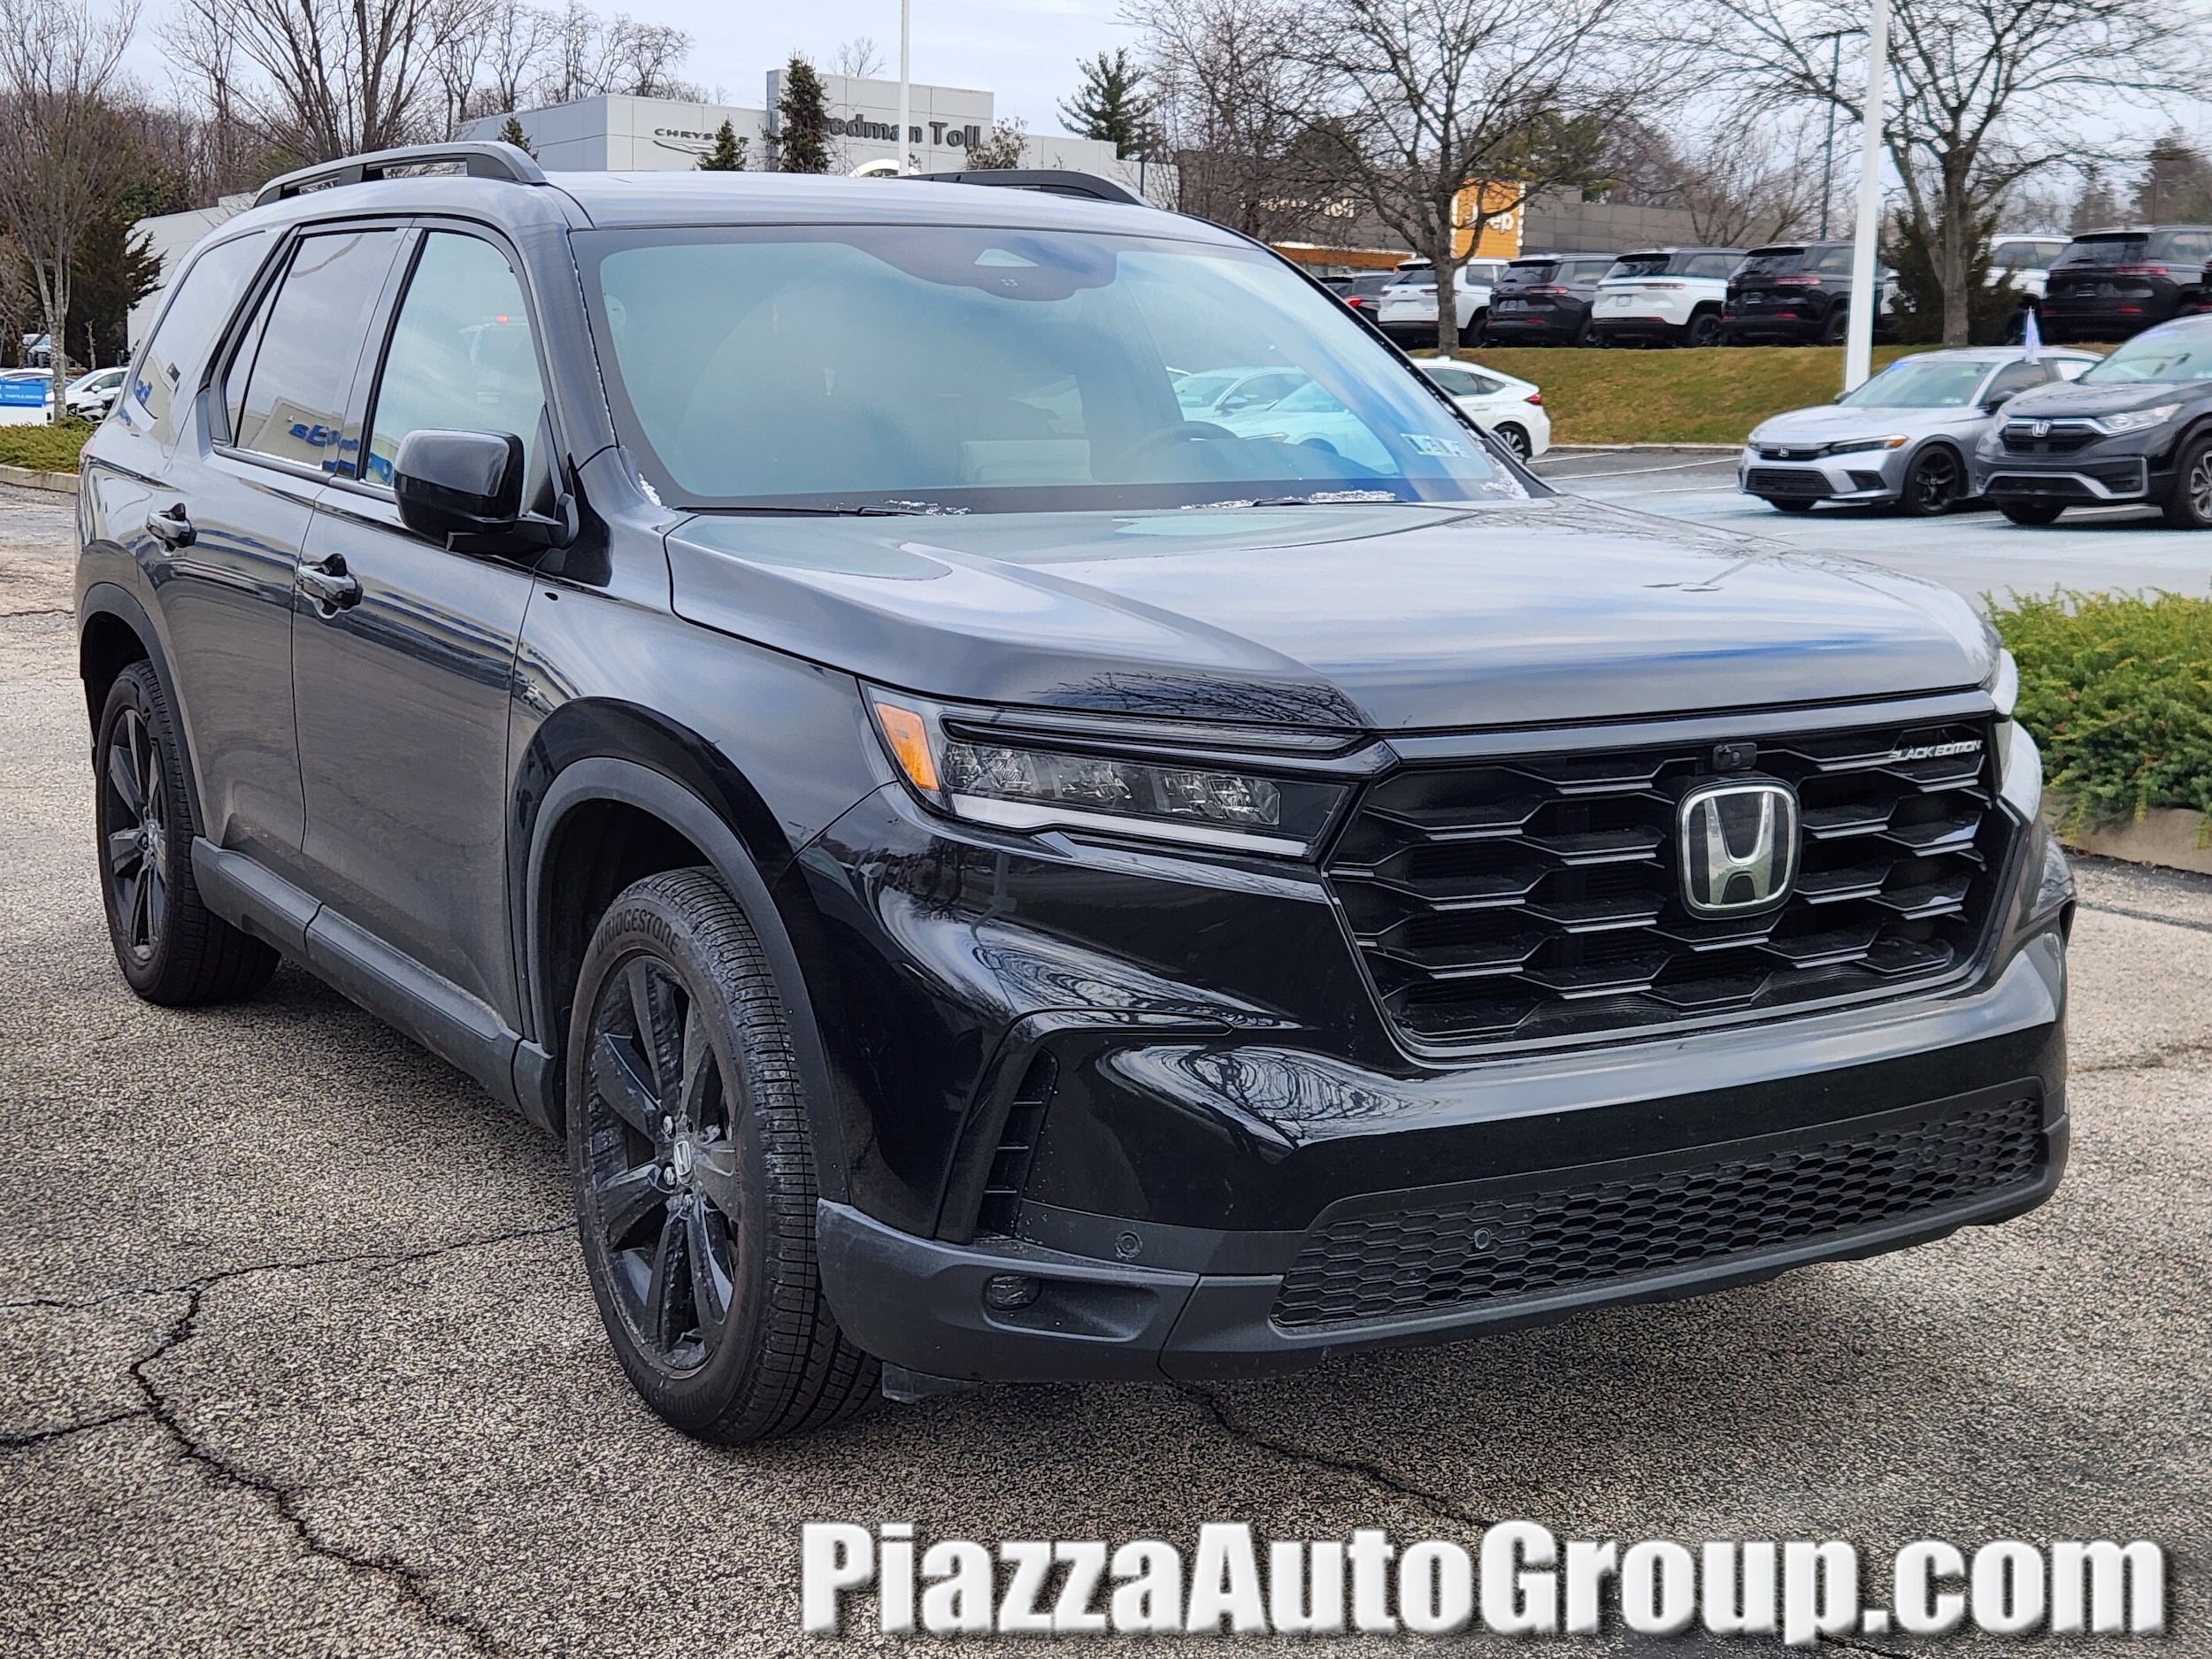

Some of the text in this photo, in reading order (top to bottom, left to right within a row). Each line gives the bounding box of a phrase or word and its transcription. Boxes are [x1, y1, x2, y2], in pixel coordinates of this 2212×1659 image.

[929, 121, 980, 150] Toll
[1934, 740, 1984, 757] EDITION
[596, 908, 681, 956] BRIDGESTONE
